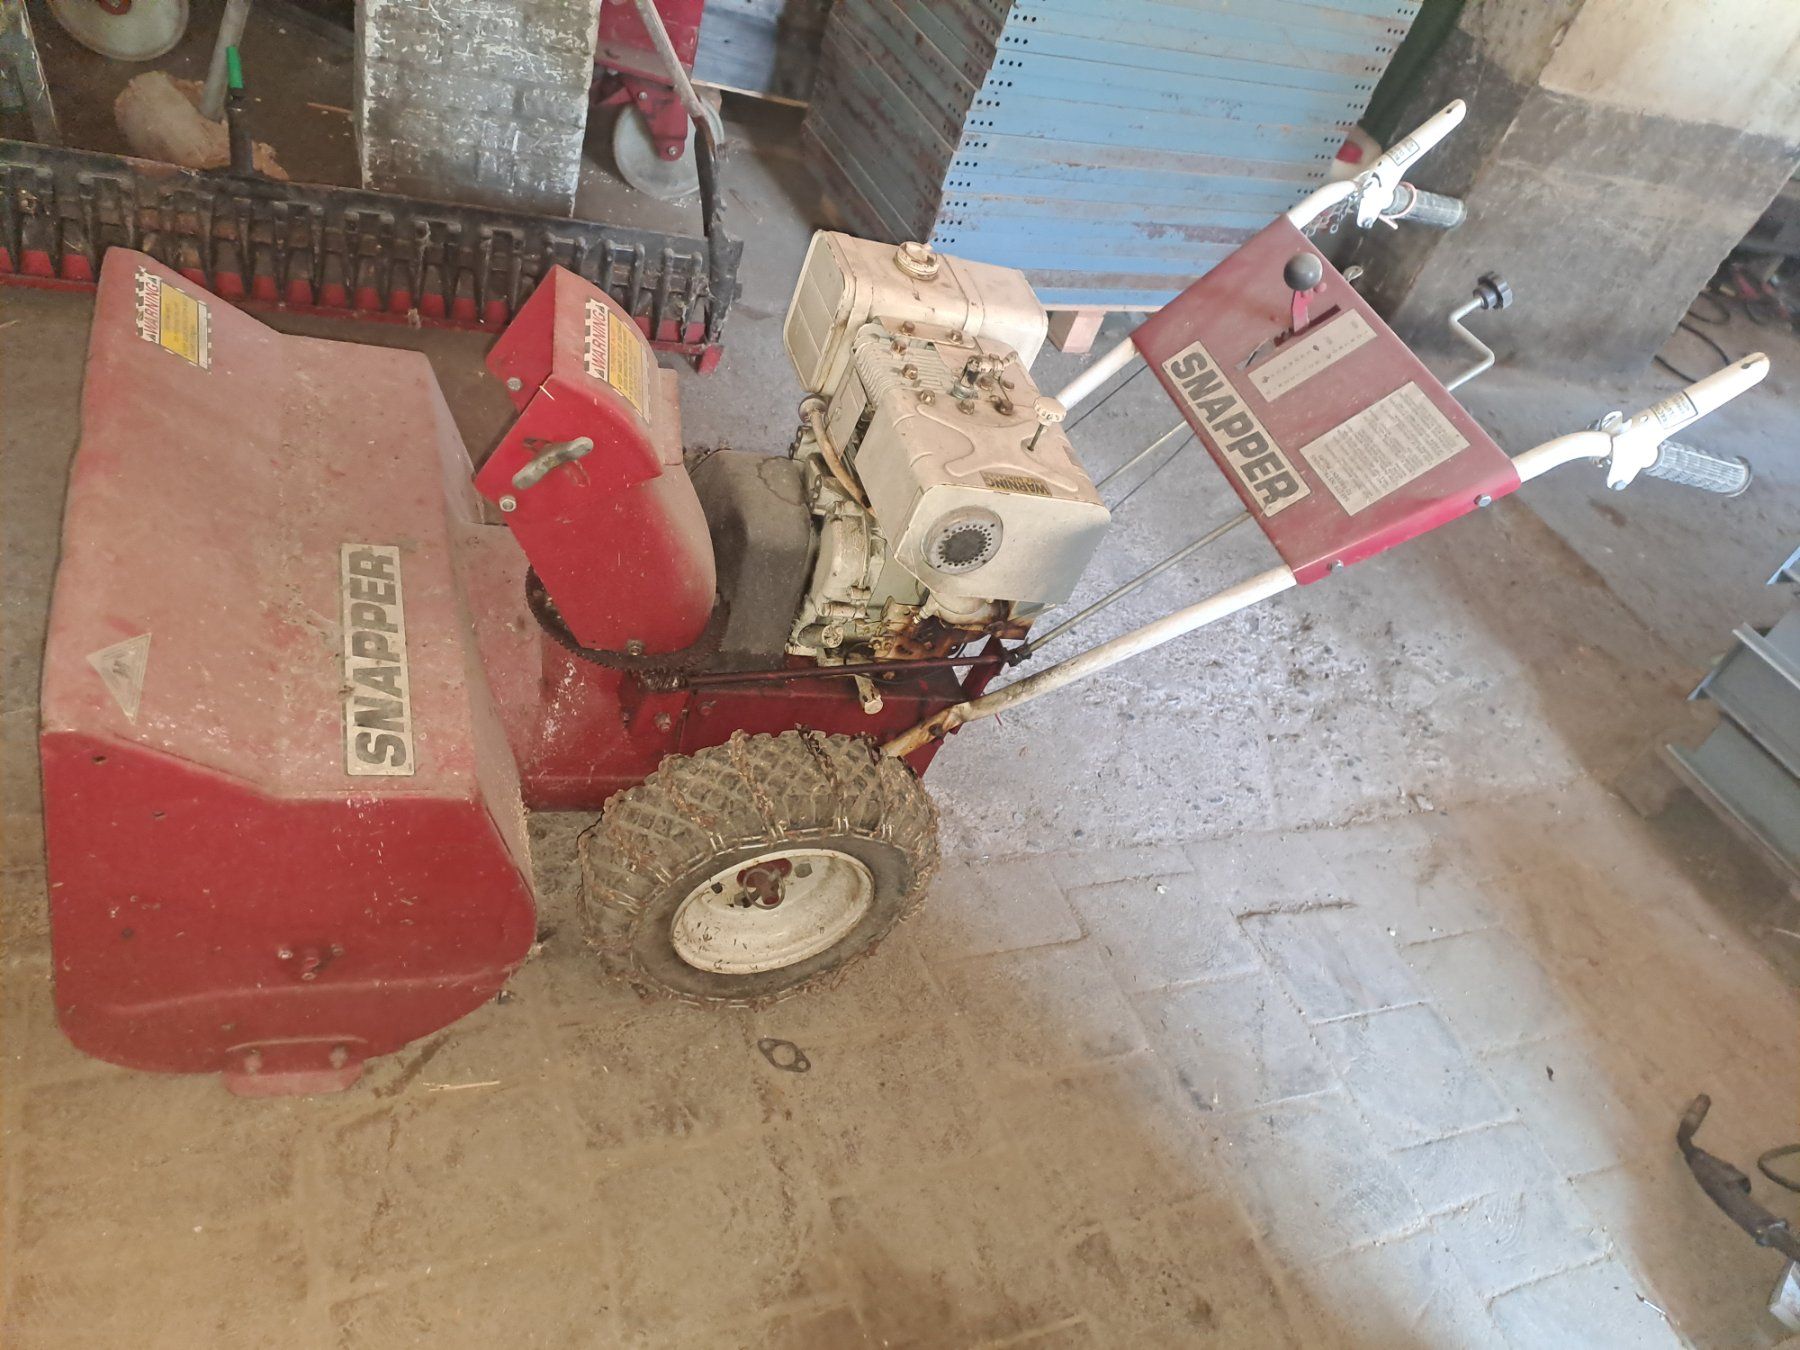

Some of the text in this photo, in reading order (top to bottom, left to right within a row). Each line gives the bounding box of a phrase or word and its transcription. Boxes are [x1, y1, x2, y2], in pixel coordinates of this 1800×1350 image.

[144, 282, 159, 335] WARNING
[592, 309, 606, 370] WARNING
[1171, 352, 1299, 505] SNAPPER
[348, 550, 407, 767] SNAPPER
